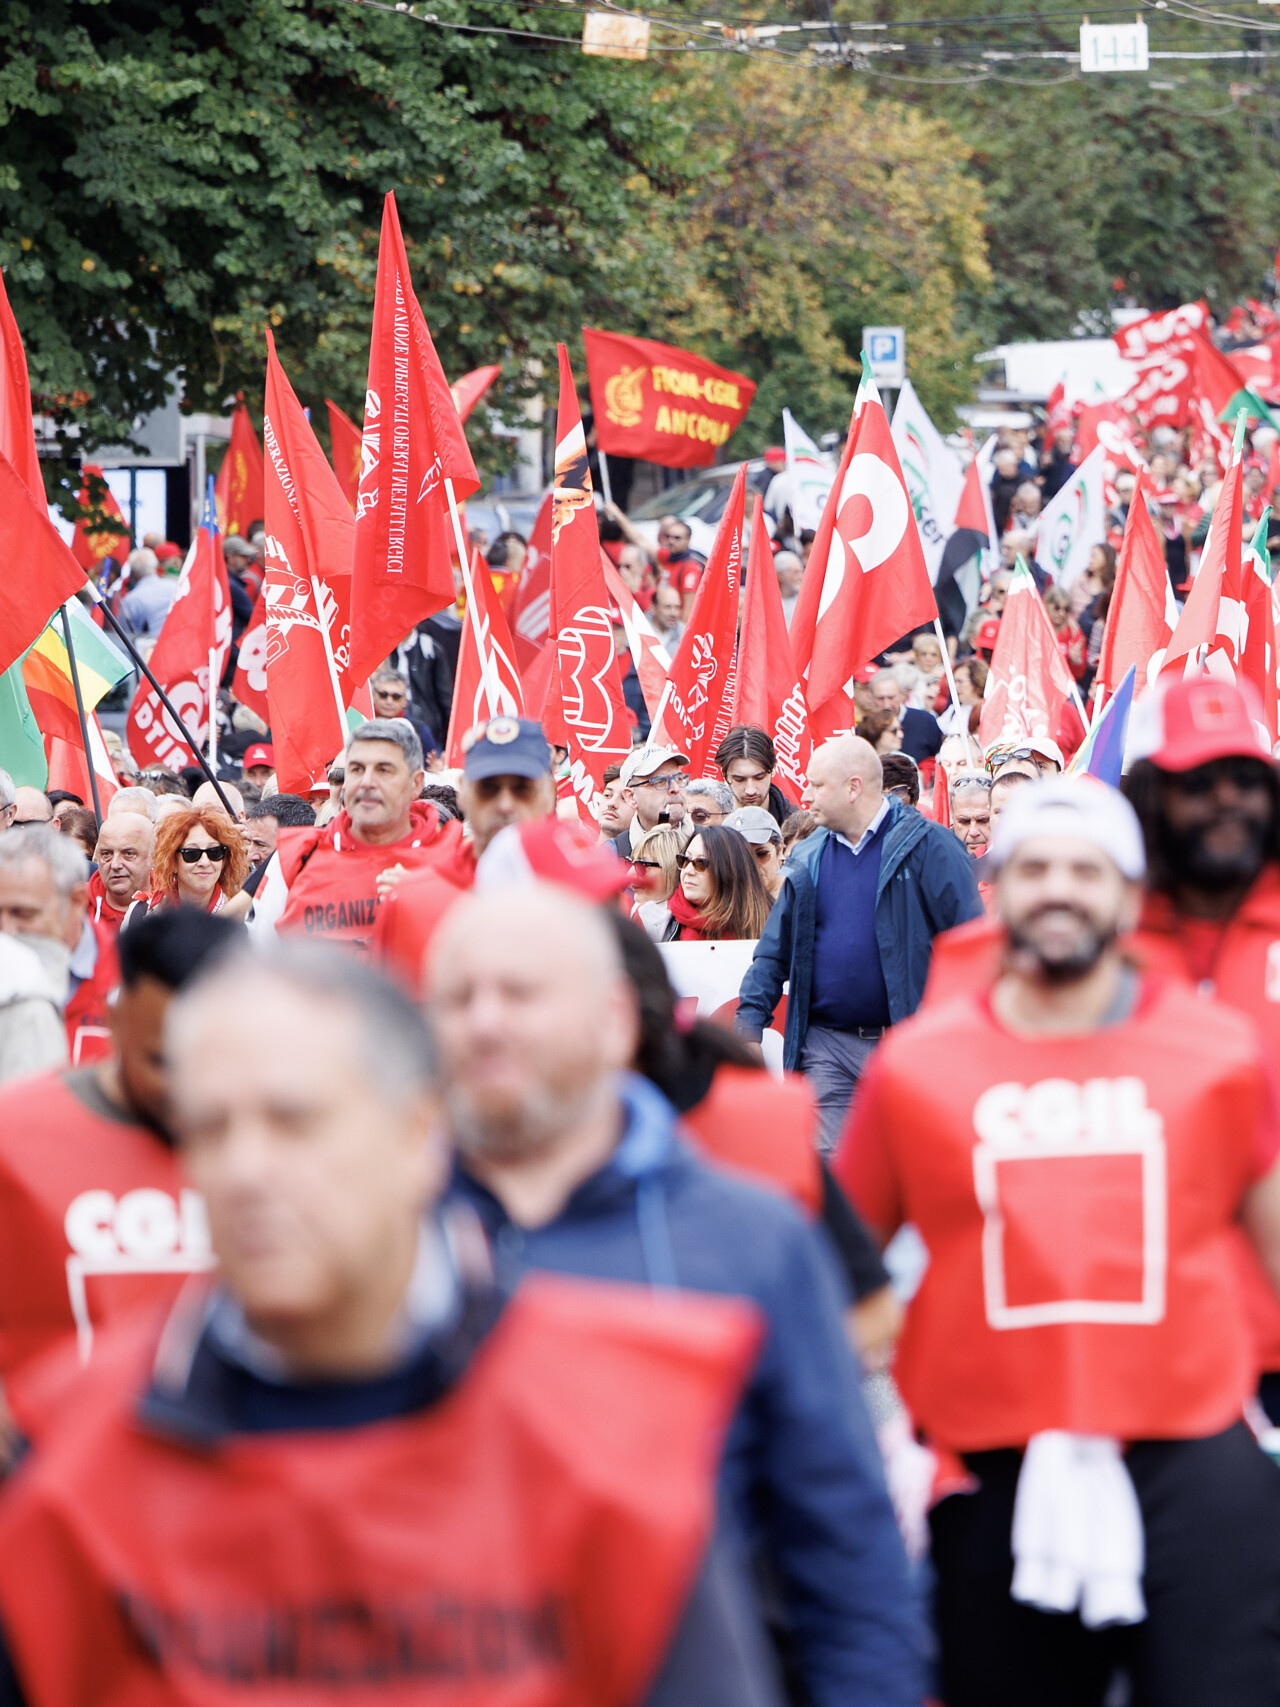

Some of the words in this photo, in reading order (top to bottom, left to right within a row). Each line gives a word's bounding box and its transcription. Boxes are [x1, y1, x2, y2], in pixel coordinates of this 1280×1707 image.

[1092, 36, 1139, 66] 144
[655, 405, 730, 446] ANCON
[304, 899, 381, 933] ORGANIZ
[972, 1077, 1164, 1150] CGIL
[63, 1187, 214, 1258] CGI
